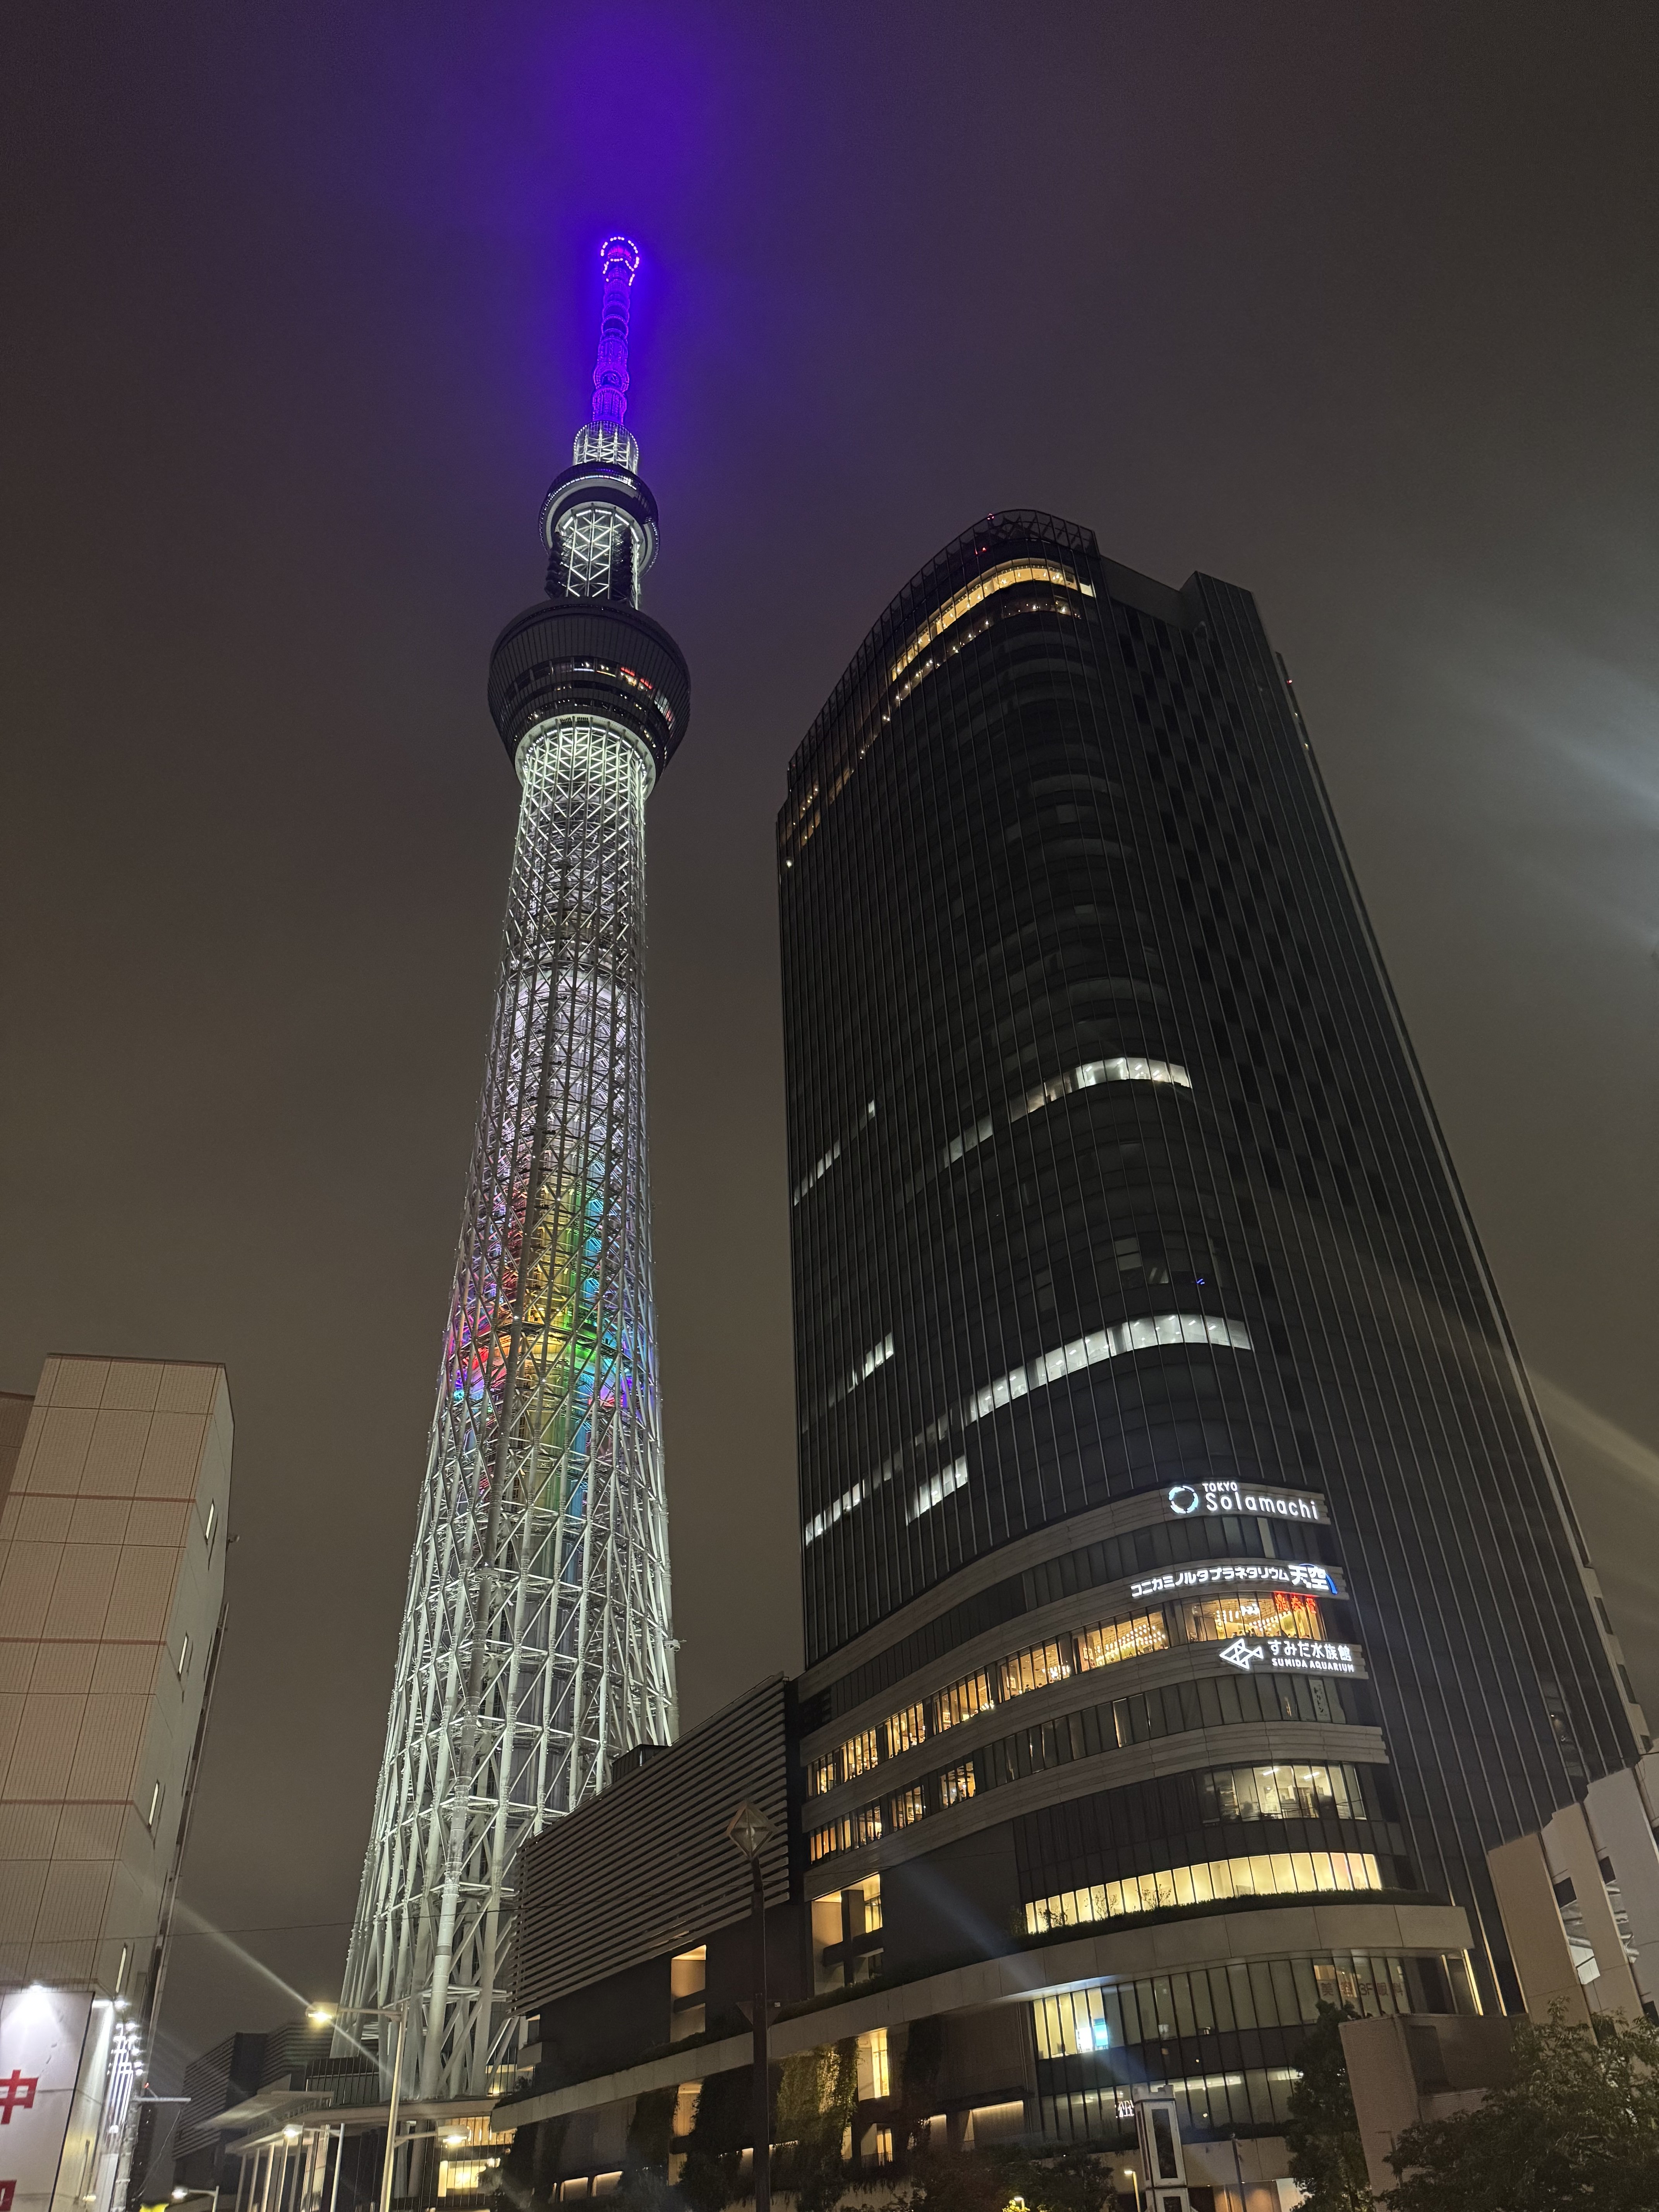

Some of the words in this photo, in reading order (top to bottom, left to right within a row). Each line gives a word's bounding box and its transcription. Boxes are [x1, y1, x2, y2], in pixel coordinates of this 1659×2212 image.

[1202, 1481, 1238, 1492] TOKYO
[1205, 1492, 1318, 1520] Solamachi
[1267, 1639, 1352, 1662] すみだ水族館
[1271, 1658, 1308, 1668] SUMIDA
[1310, 1660, 1355, 1673] AQUARIUM
